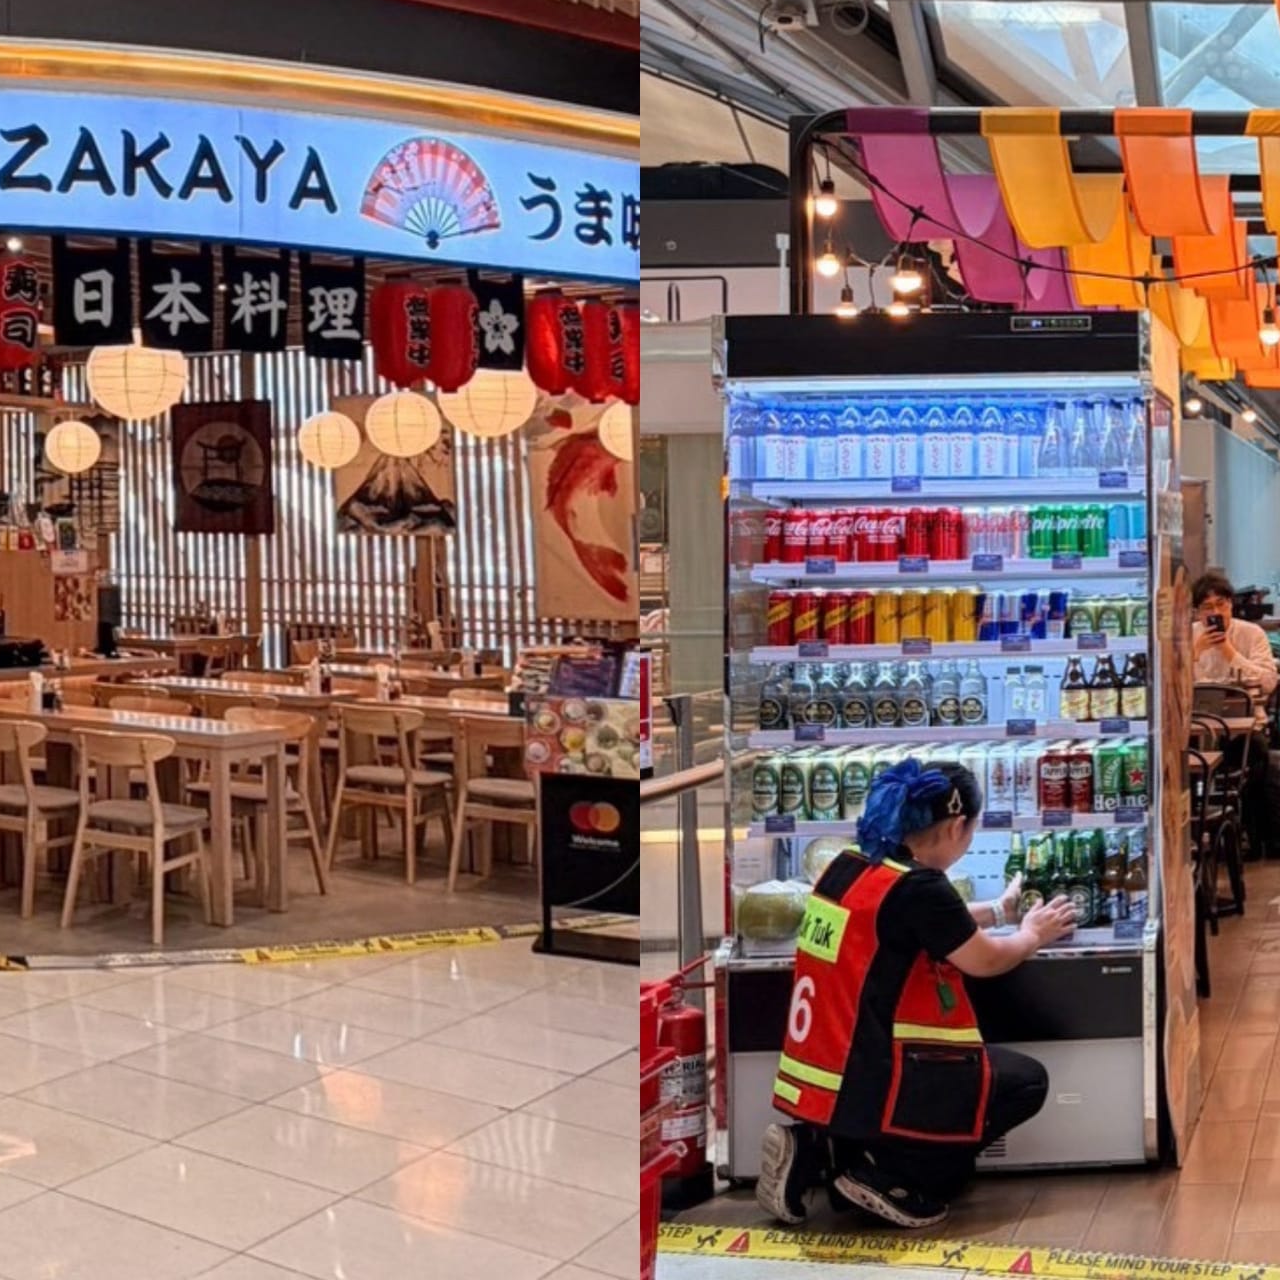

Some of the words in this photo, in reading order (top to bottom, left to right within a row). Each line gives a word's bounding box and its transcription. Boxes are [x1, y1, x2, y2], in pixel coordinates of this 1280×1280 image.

[70, 266, 363, 342] 日本料理
[810, 917, 834, 949] Tuk
[788, 975, 816, 1043] 6
[762, 1230, 818, 1247] PLEASE
[818, 1234, 858, 1249] MIND
[859, 1236, 899, 1252] YOUR
[899, 1240, 939, 1255] STEP
[1046, 1250, 1103, 1269] PLEASE
[1104, 1254, 1147, 1271] MIND
[1149, 1259, 1191, 1275] YOUR
[1191, 1261, 1233, 1278] STEP
